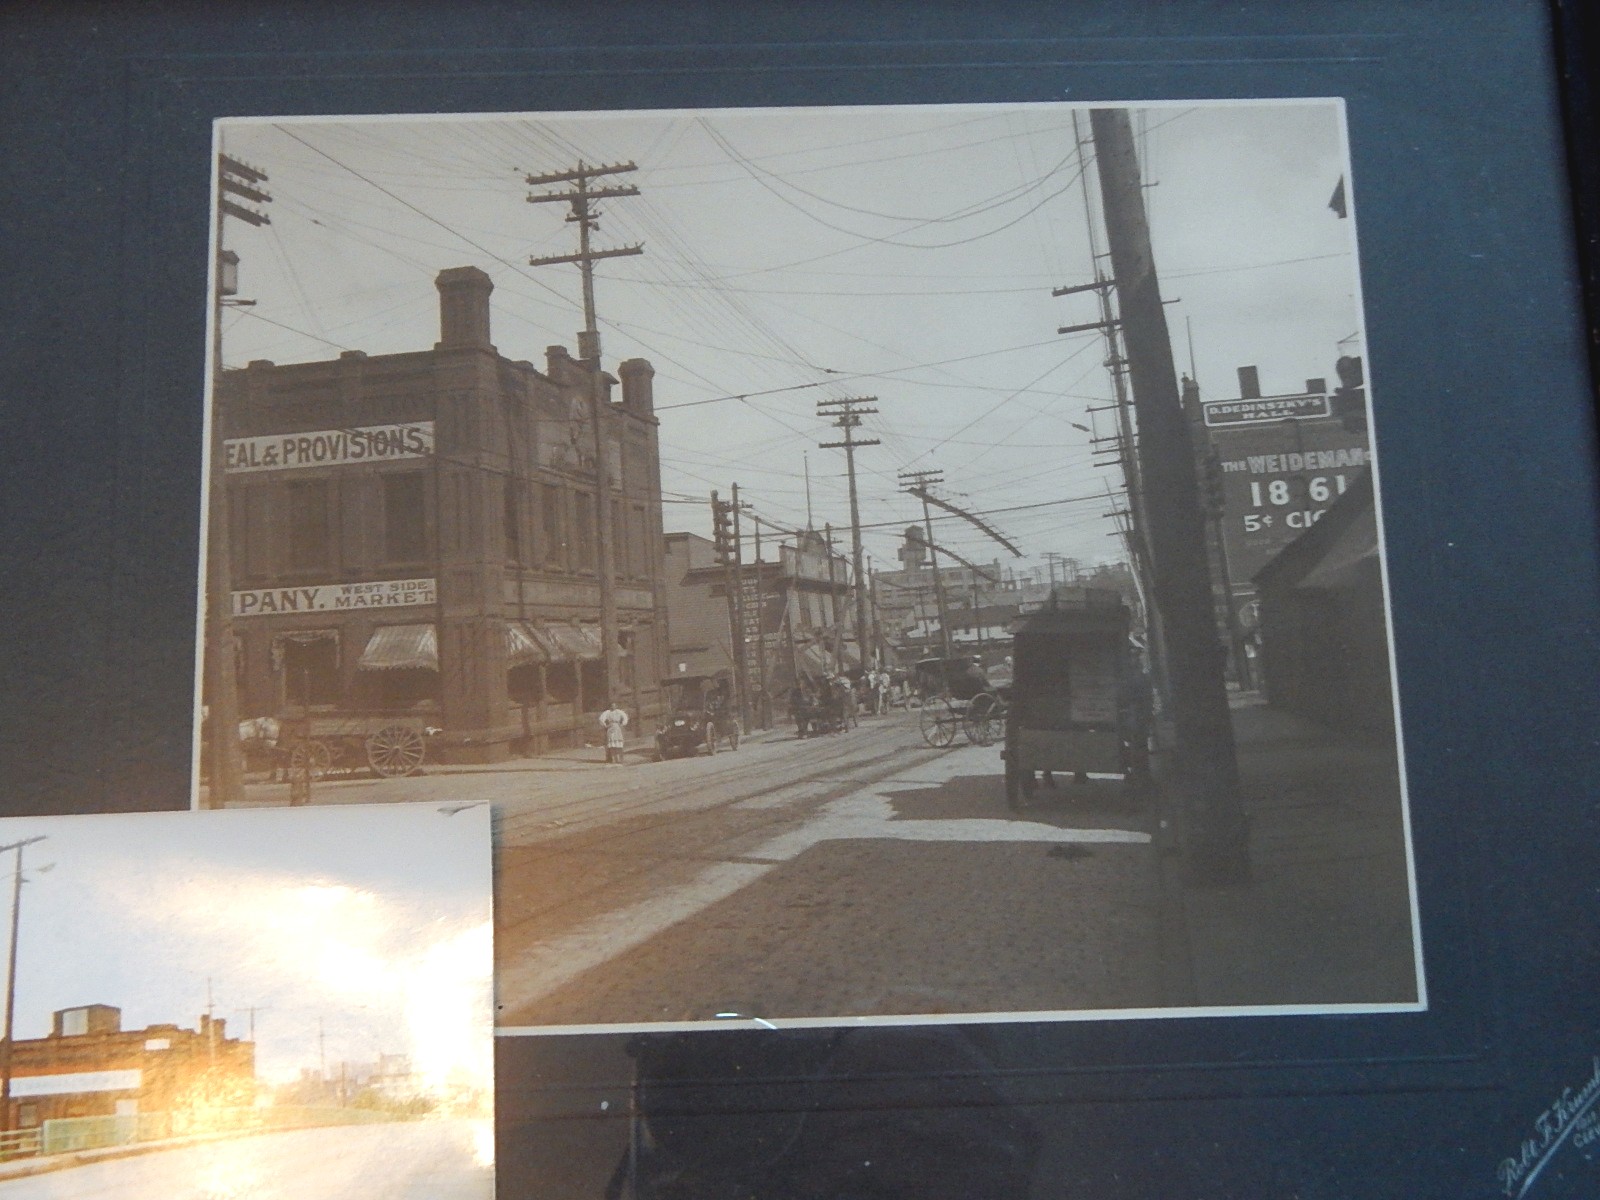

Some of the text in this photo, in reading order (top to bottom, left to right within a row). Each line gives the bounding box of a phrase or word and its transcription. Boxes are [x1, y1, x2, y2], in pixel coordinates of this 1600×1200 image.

[1243, 410, 1294, 419] HALL
[1221, 460, 1248, 473] THE
[341, 580, 429, 596] WEST SIDE
